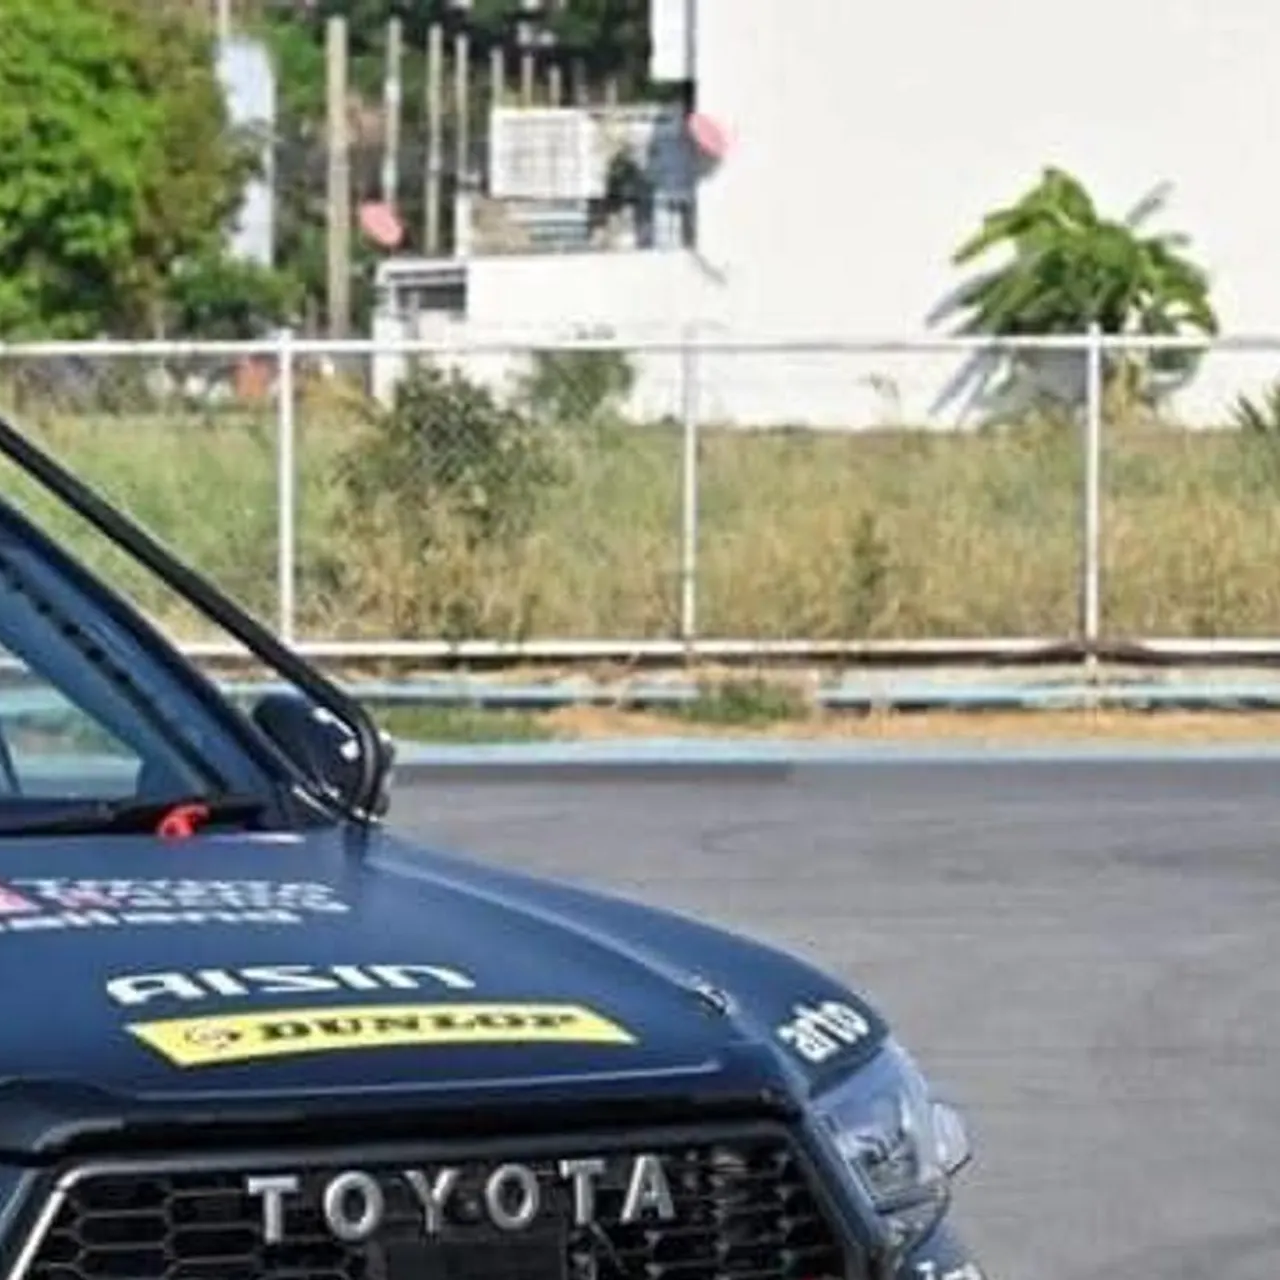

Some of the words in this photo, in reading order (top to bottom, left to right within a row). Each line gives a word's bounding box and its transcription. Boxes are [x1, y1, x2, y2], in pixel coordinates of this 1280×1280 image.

[106, 963, 476, 1005] AISIN
[257, 1011, 581, 1042] DUNLOP
[246, 1153, 676, 1246] TOYOTA
